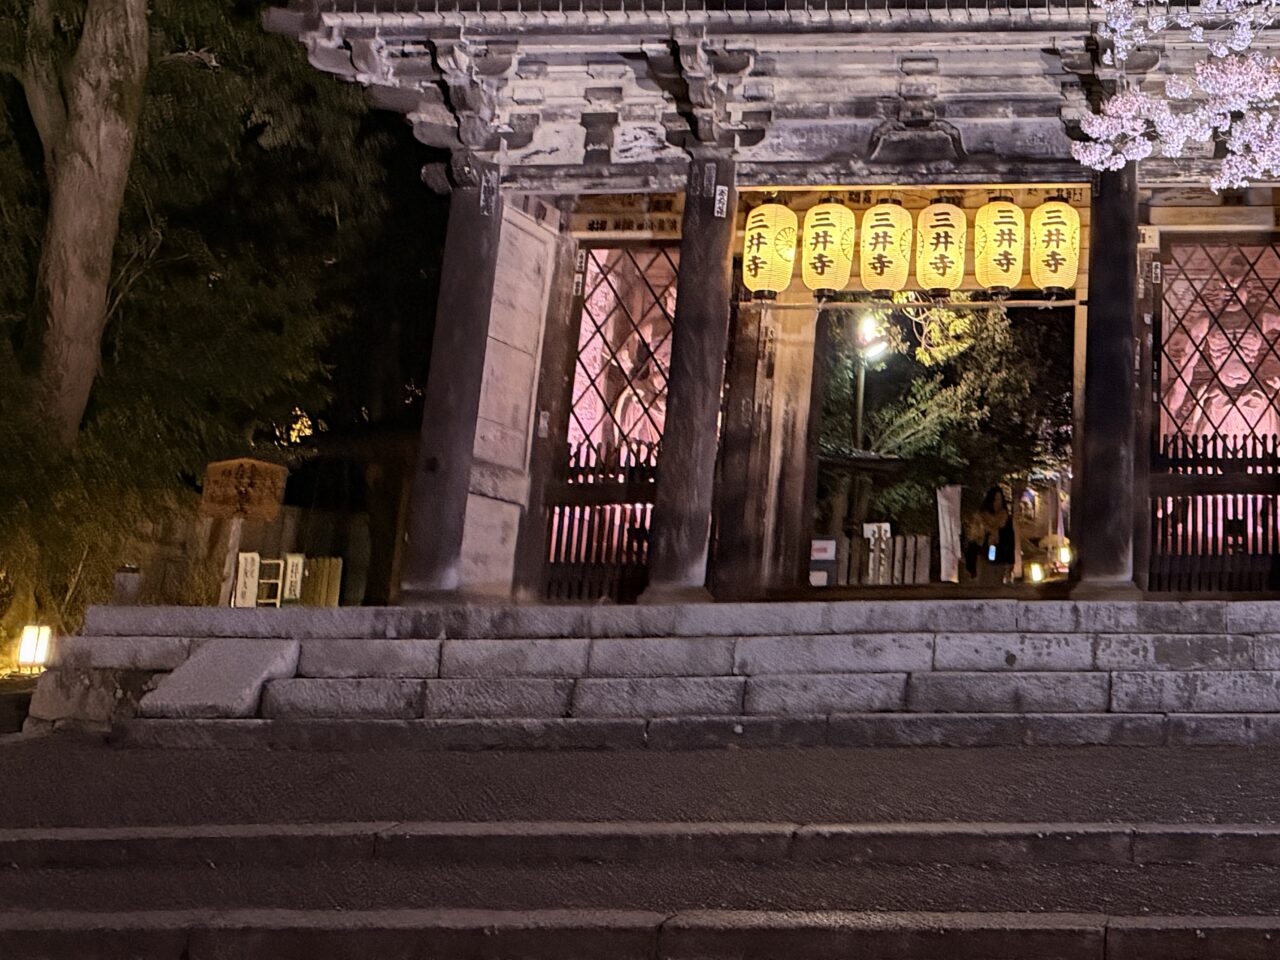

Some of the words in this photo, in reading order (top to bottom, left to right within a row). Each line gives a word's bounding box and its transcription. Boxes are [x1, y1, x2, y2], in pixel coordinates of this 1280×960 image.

[746, 211, 770, 278] 三井寺
[809, 211, 836, 277] 三井寺
[868, 211, 896, 277] 三井寺
[929, 211, 956, 278] 三井寺
[992, 209, 1019, 274] 三井寺
[1041, 209, 1068, 275] 三井寺
